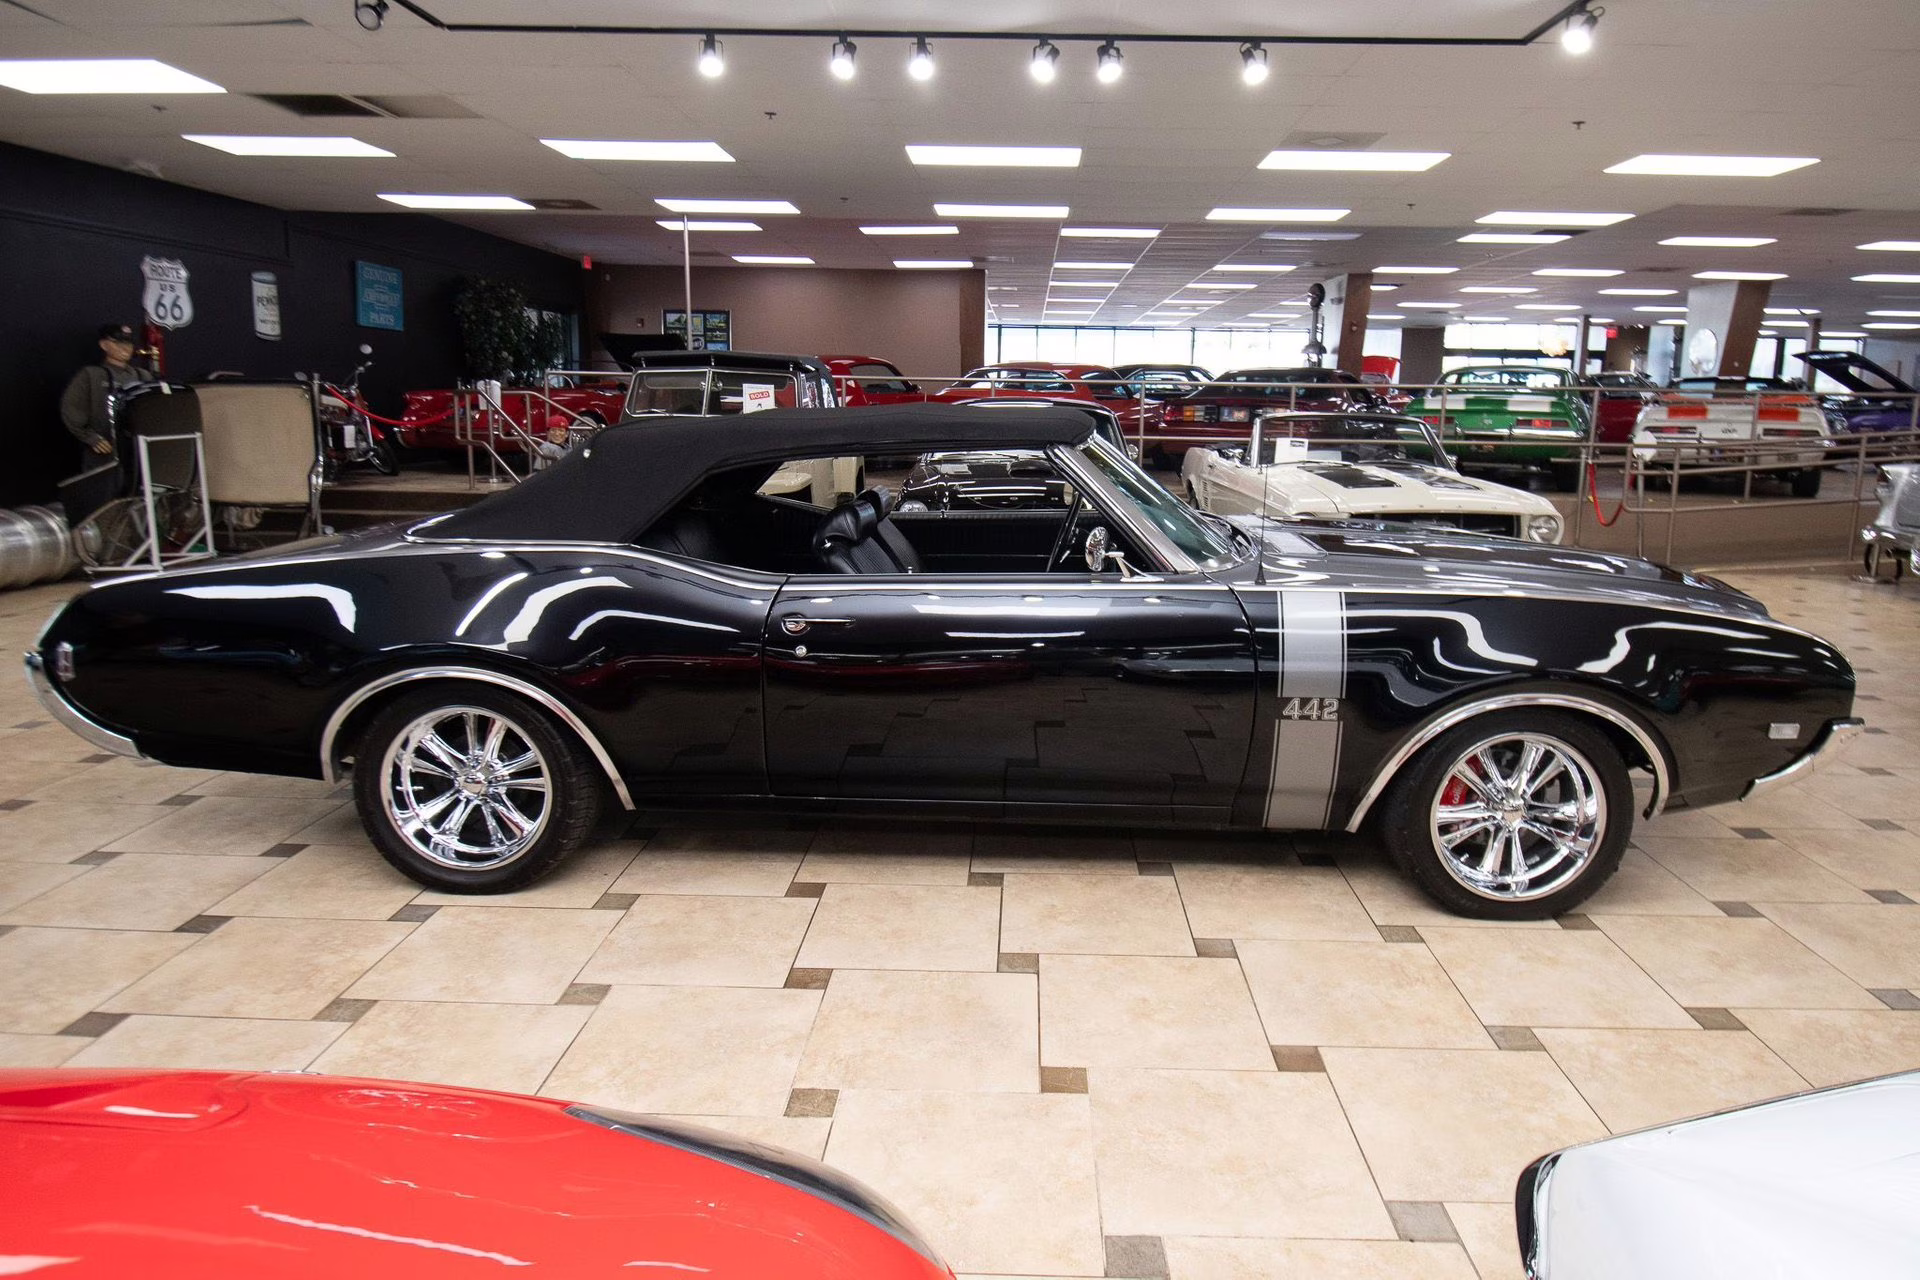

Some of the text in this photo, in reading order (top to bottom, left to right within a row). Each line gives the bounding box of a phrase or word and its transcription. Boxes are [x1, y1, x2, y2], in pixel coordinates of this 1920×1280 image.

[150, 264, 182, 280] ROUTE
[155, 294, 184, 321] 66
[370, 312, 395, 326] PARTS
[750, 391, 769, 400] SOLD
[1283, 698, 1339, 720] 442
